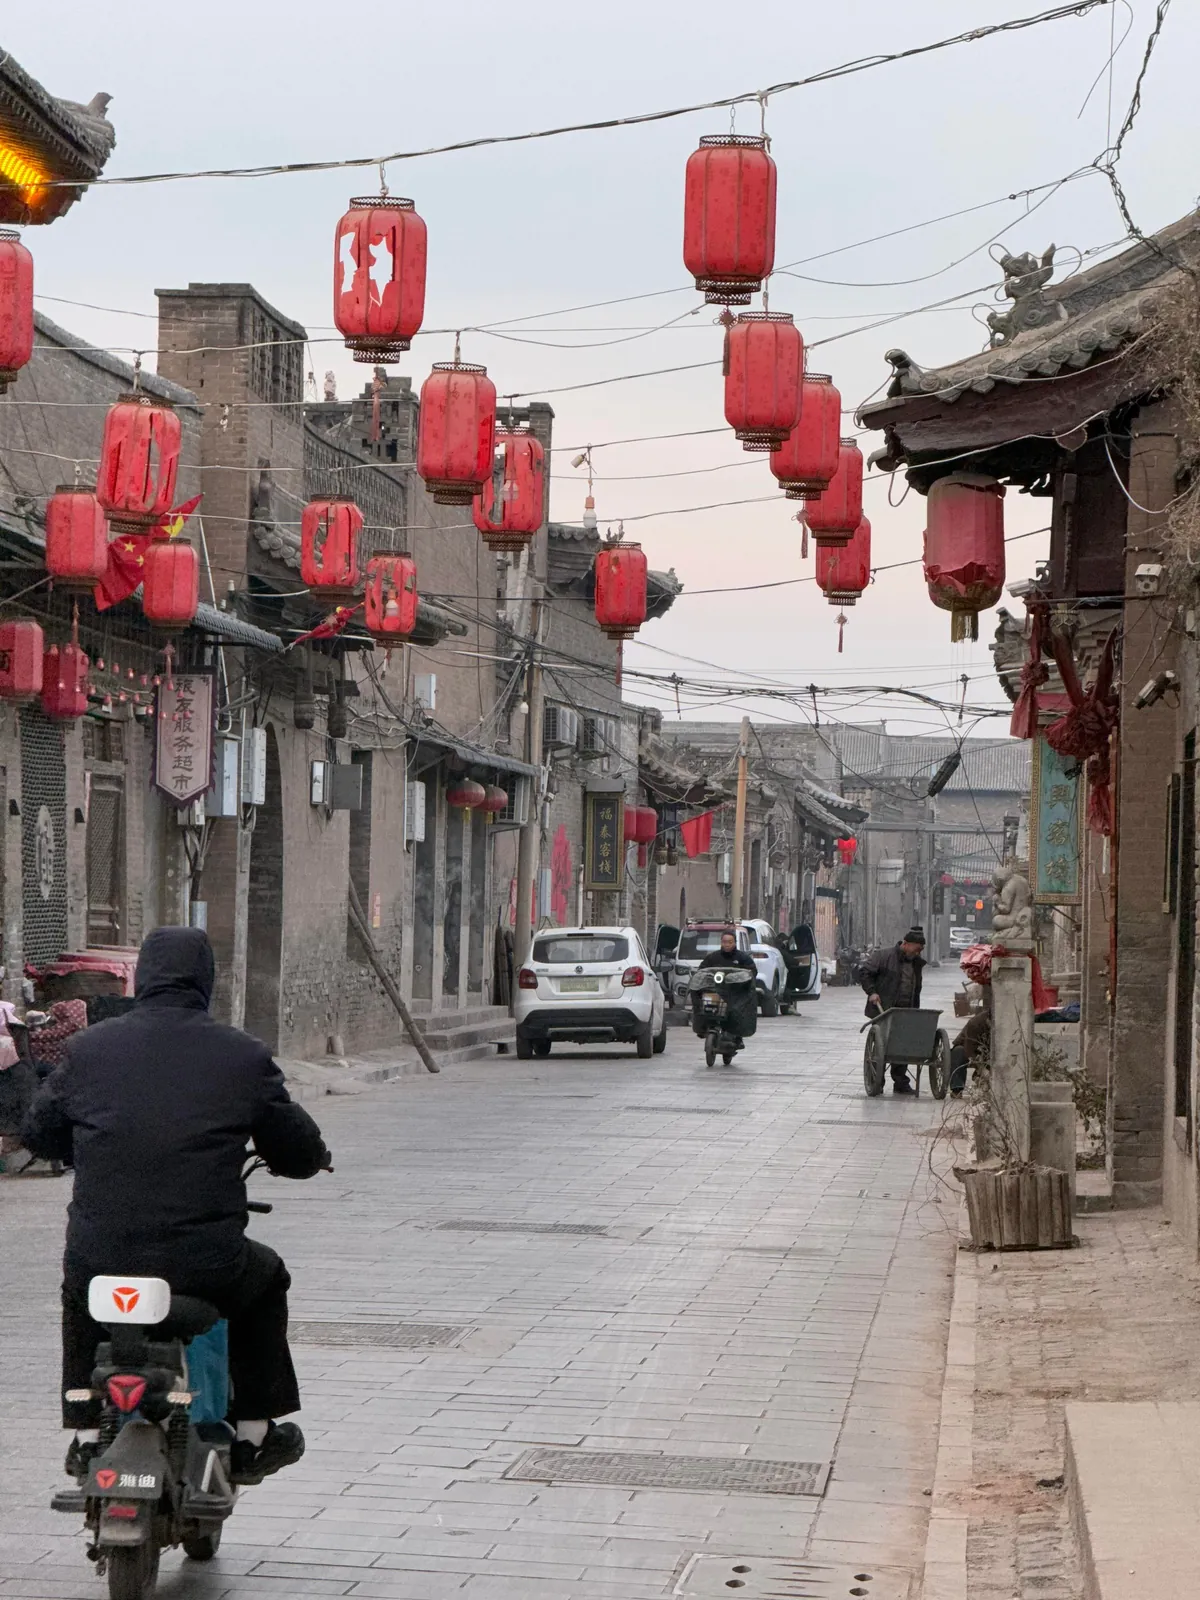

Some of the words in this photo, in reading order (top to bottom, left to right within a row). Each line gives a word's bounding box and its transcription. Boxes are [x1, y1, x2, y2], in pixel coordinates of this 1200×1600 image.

[598, 807, 613, 875] 福泰客栈
[118, 1474, 156, 1488] 雅迪
